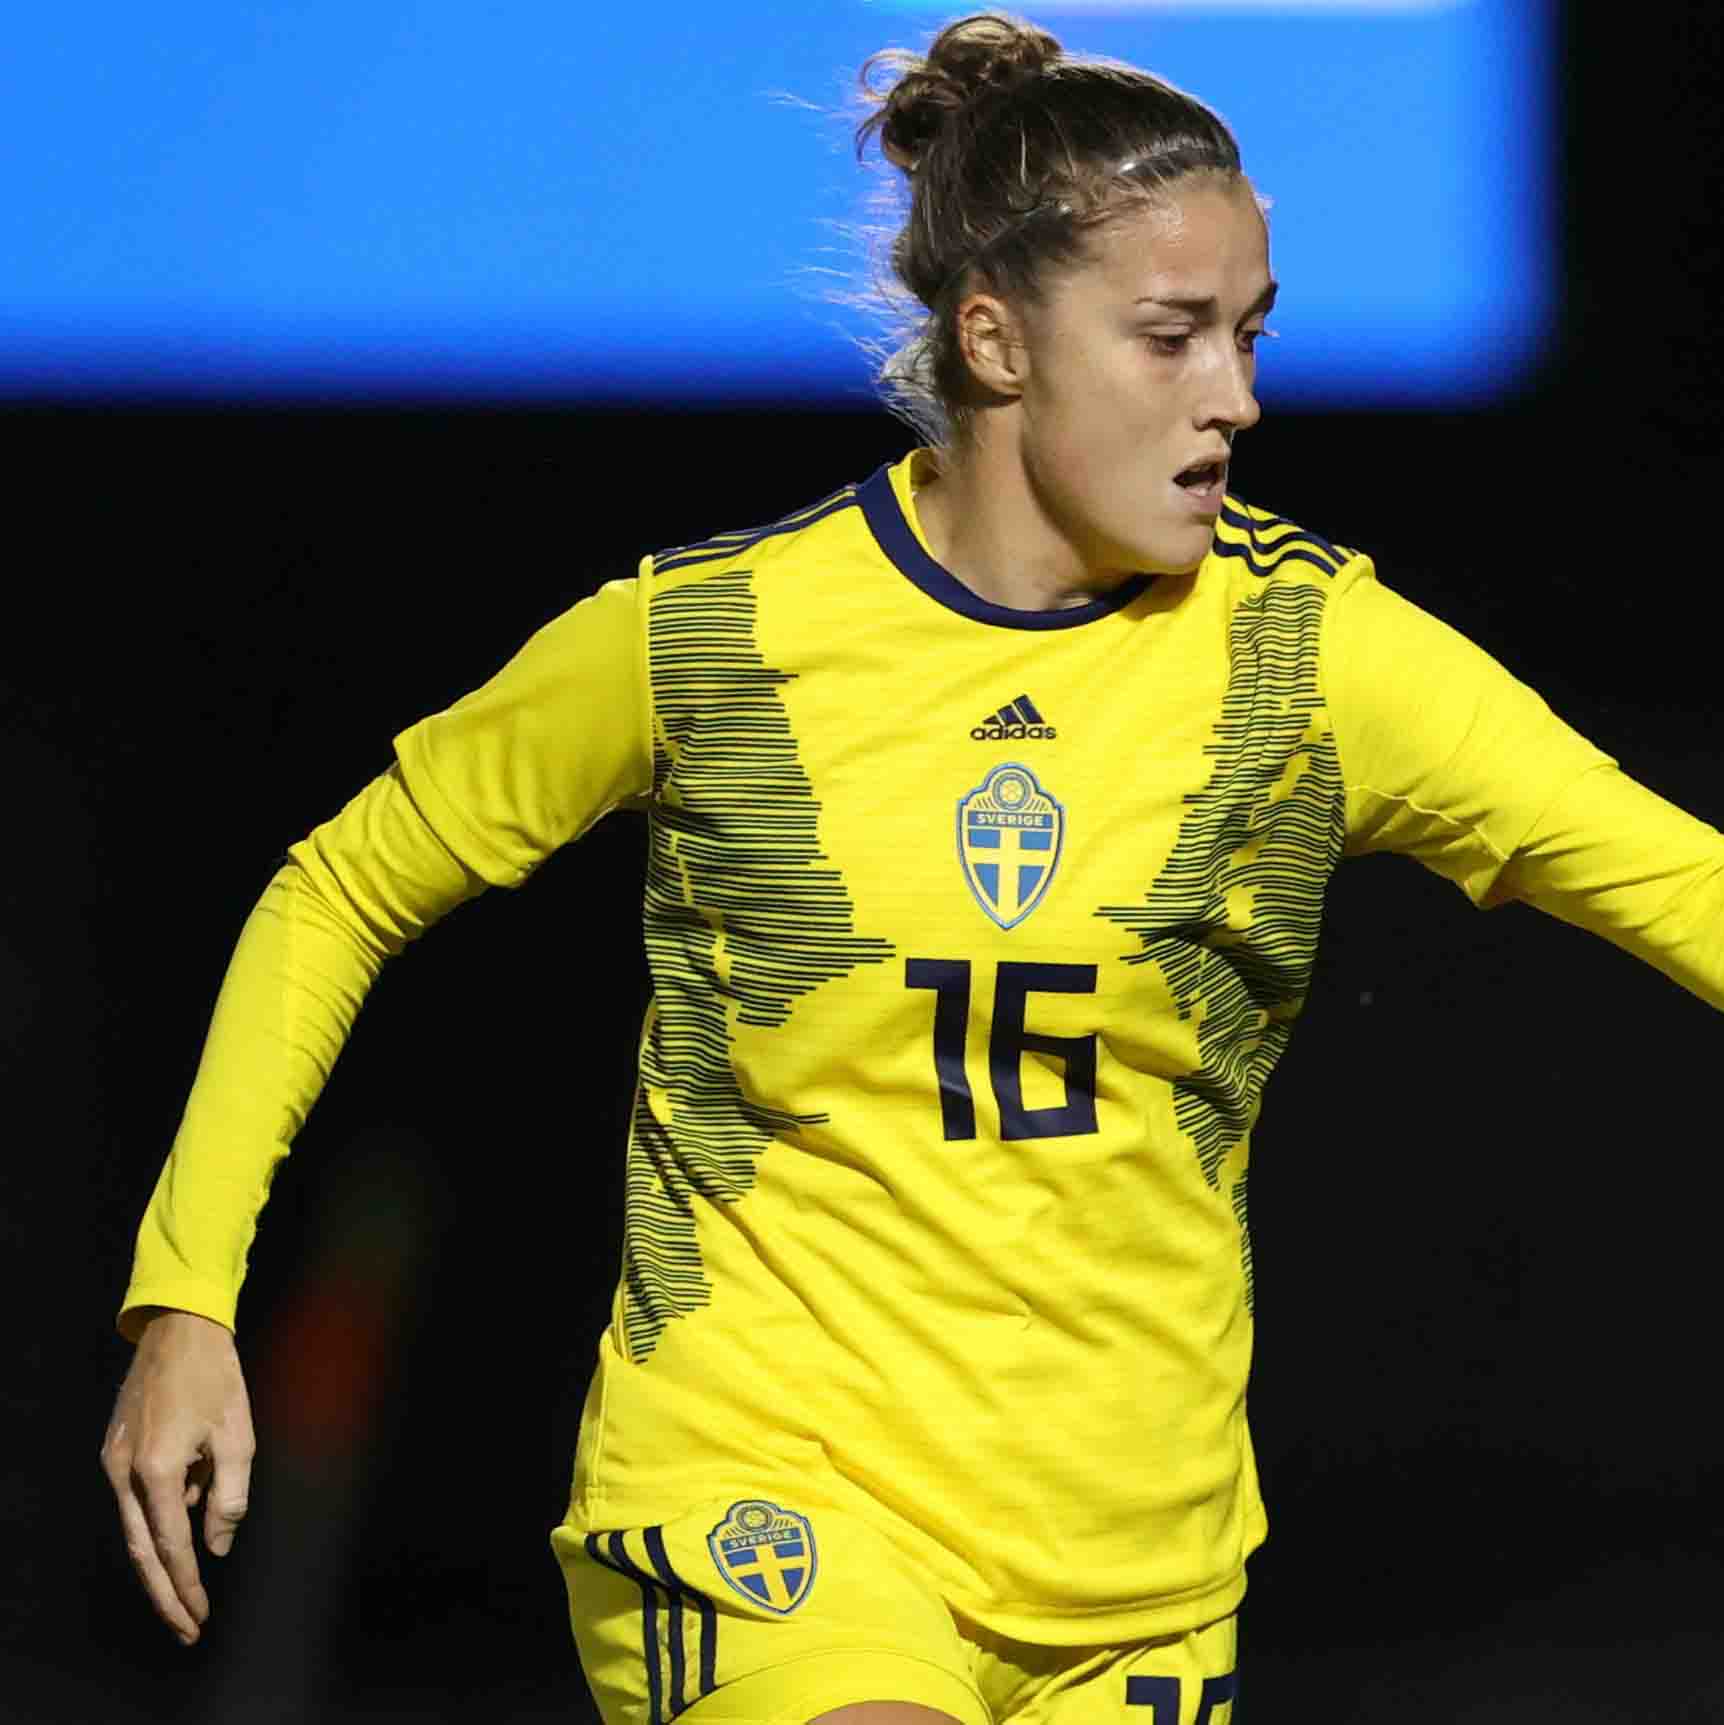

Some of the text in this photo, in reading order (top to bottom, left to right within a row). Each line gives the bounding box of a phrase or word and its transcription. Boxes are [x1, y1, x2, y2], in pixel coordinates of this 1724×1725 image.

[970, 724, 1057, 741] adidas
[976, 813, 1044, 827] SVERIGE
[905, 958, 1099, 1142] 16
[730, 1529, 793, 1549] SVERIGE
